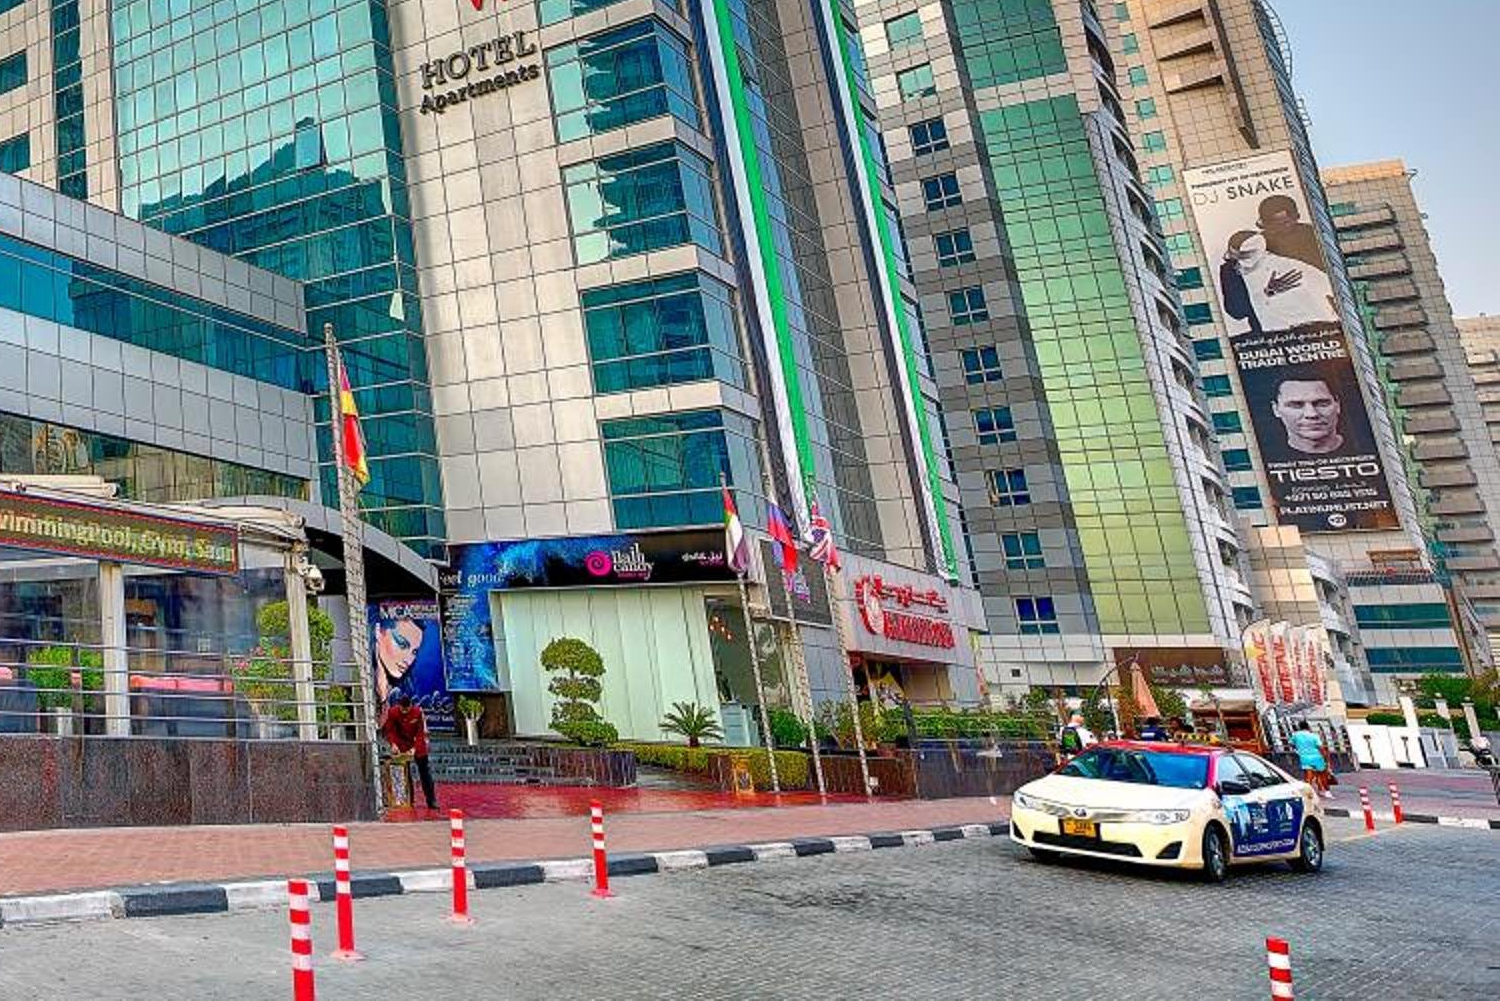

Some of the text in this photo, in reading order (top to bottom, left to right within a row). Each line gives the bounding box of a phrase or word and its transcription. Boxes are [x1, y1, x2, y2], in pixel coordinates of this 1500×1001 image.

[419, 30, 538, 90] HOTEL
[419, 64, 540, 116] Apartments
[1226, 174, 1295, 200] SNAKE
[1238, 340, 1342, 360] DUBAI WORLD
[1288, 349, 1348, 365] CENTRE
